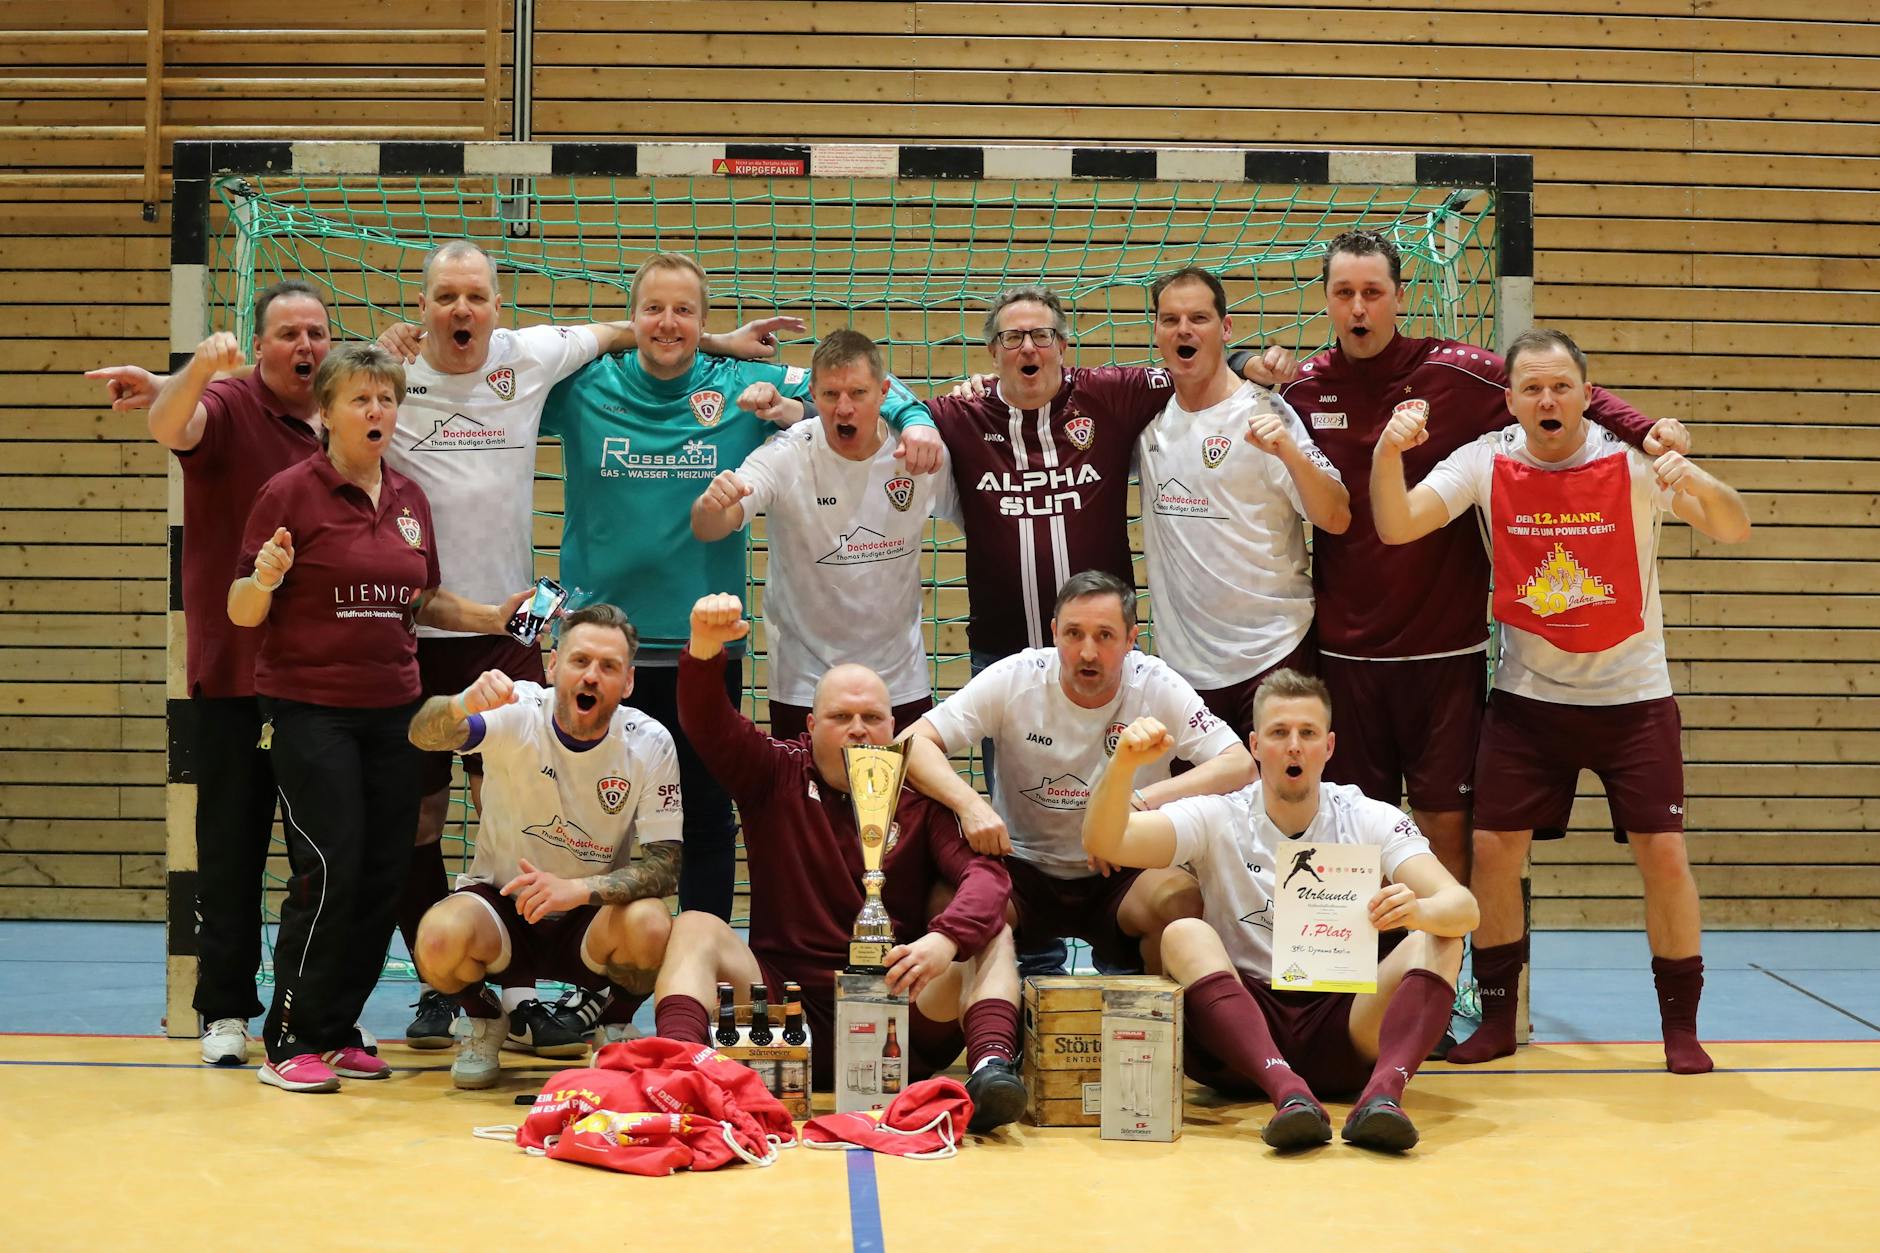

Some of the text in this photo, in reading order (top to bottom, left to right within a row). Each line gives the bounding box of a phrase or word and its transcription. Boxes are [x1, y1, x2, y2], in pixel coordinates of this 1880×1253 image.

[735, 165, 799, 175] KIPPGEFAHR!
[488, 370, 512, 383] BFC
[406, 386, 427, 395] AKO
[693, 391, 720, 404] BFC
[1318, 395, 1338, 403] JAKO
[1067, 418, 1090, 431] BFC
[442, 427, 505, 439] Dachdeckerei
[983, 432, 1005, 442] JAKO
[458, 438, 484, 447] Rüdiger
[1206, 438, 1229, 449] BFC
[600, 468, 620, 477] GAS
[628, 470, 668, 479] WASSER
[677, 470, 717, 479] HEIZUNG
[976, 463, 1102, 492] ALPHA
[887, 479, 911, 491] BFC
[816, 497, 837, 506] AKO
[1160, 493, 1209, 506] Dachdeckerei
[1190, 505, 1209, 513] GmbH
[1533, 512, 1558, 525] 12.
[1560, 512, 1604, 524] MANN,
[1507, 523, 1616, 536] WENN ES UM POWER GEHT!
[847, 537, 905, 552] Dachdeckerei
[836, 547, 904, 561] Thomas Rüdiger GmbH
[1531, 592, 1568, 615] 30
[1568, 595, 1595, 608] Jahre
[336, 609, 403, 620] Wildfrucht-Verarbeitung
[1025, 732, 1053, 746] JAKO
[600, 779, 627, 791] BFC
[1035, 792, 1060, 804] Thomas
[589, 850, 612, 859] GmbH
[1246, 862, 1261, 873] KO
[1297, 886, 1359, 902] Urkunde
[1479, 988, 1506, 997] JAKO
[1054, 1036, 1102, 1055] Störte
[536, 1093, 553, 1103] EIN
[657, 1090, 682, 1110] DEIN
